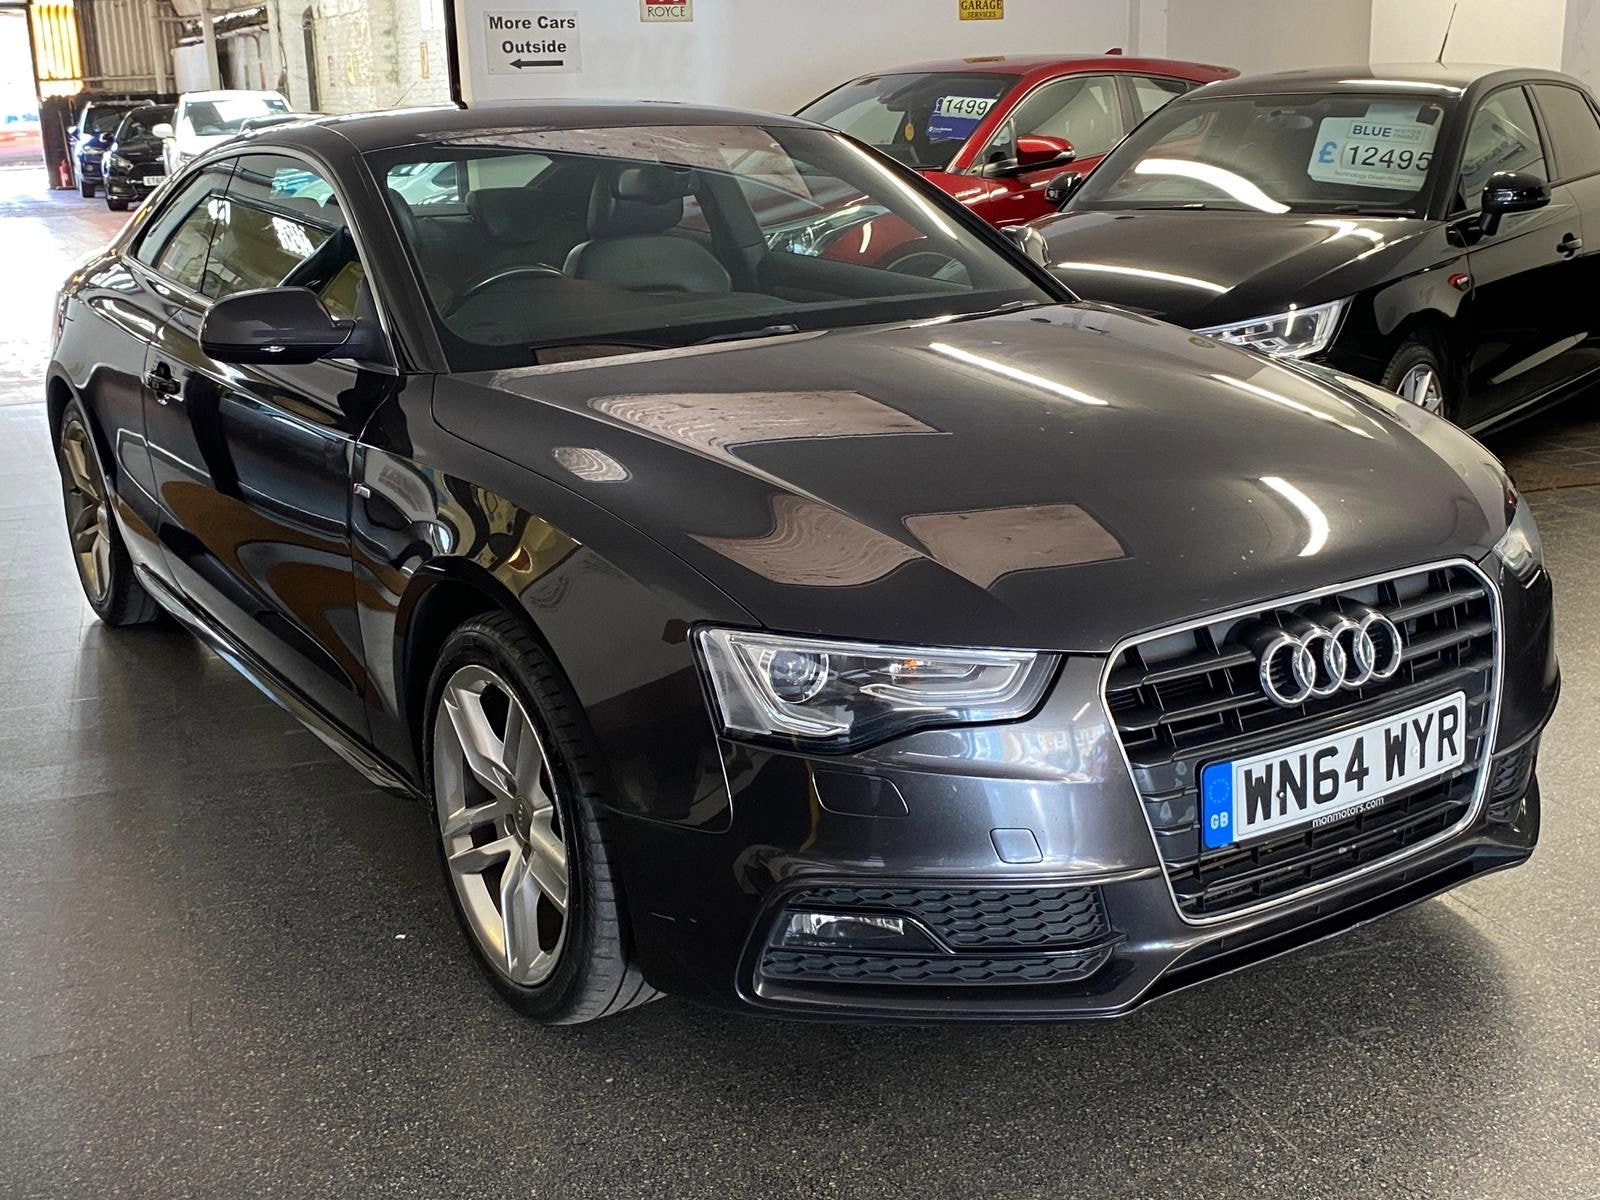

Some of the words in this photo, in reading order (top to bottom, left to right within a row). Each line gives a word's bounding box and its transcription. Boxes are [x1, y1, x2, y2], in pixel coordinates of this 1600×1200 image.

[647, 6, 686, 17] ROYCE
[961, 0, 1003, 10] GARAGE
[489, 16, 531, 30] More
[537, 16, 576, 29] Cars
[502, 40, 567, 53] Outside
[1352, 125, 1392, 137] BLUE
[1244, 737, 1369, 825] WN64
[1384, 704, 1459, 782] WYR
[1312, 797, 1385, 828] monmotors.com
[1210, 811, 1229, 830] GB
